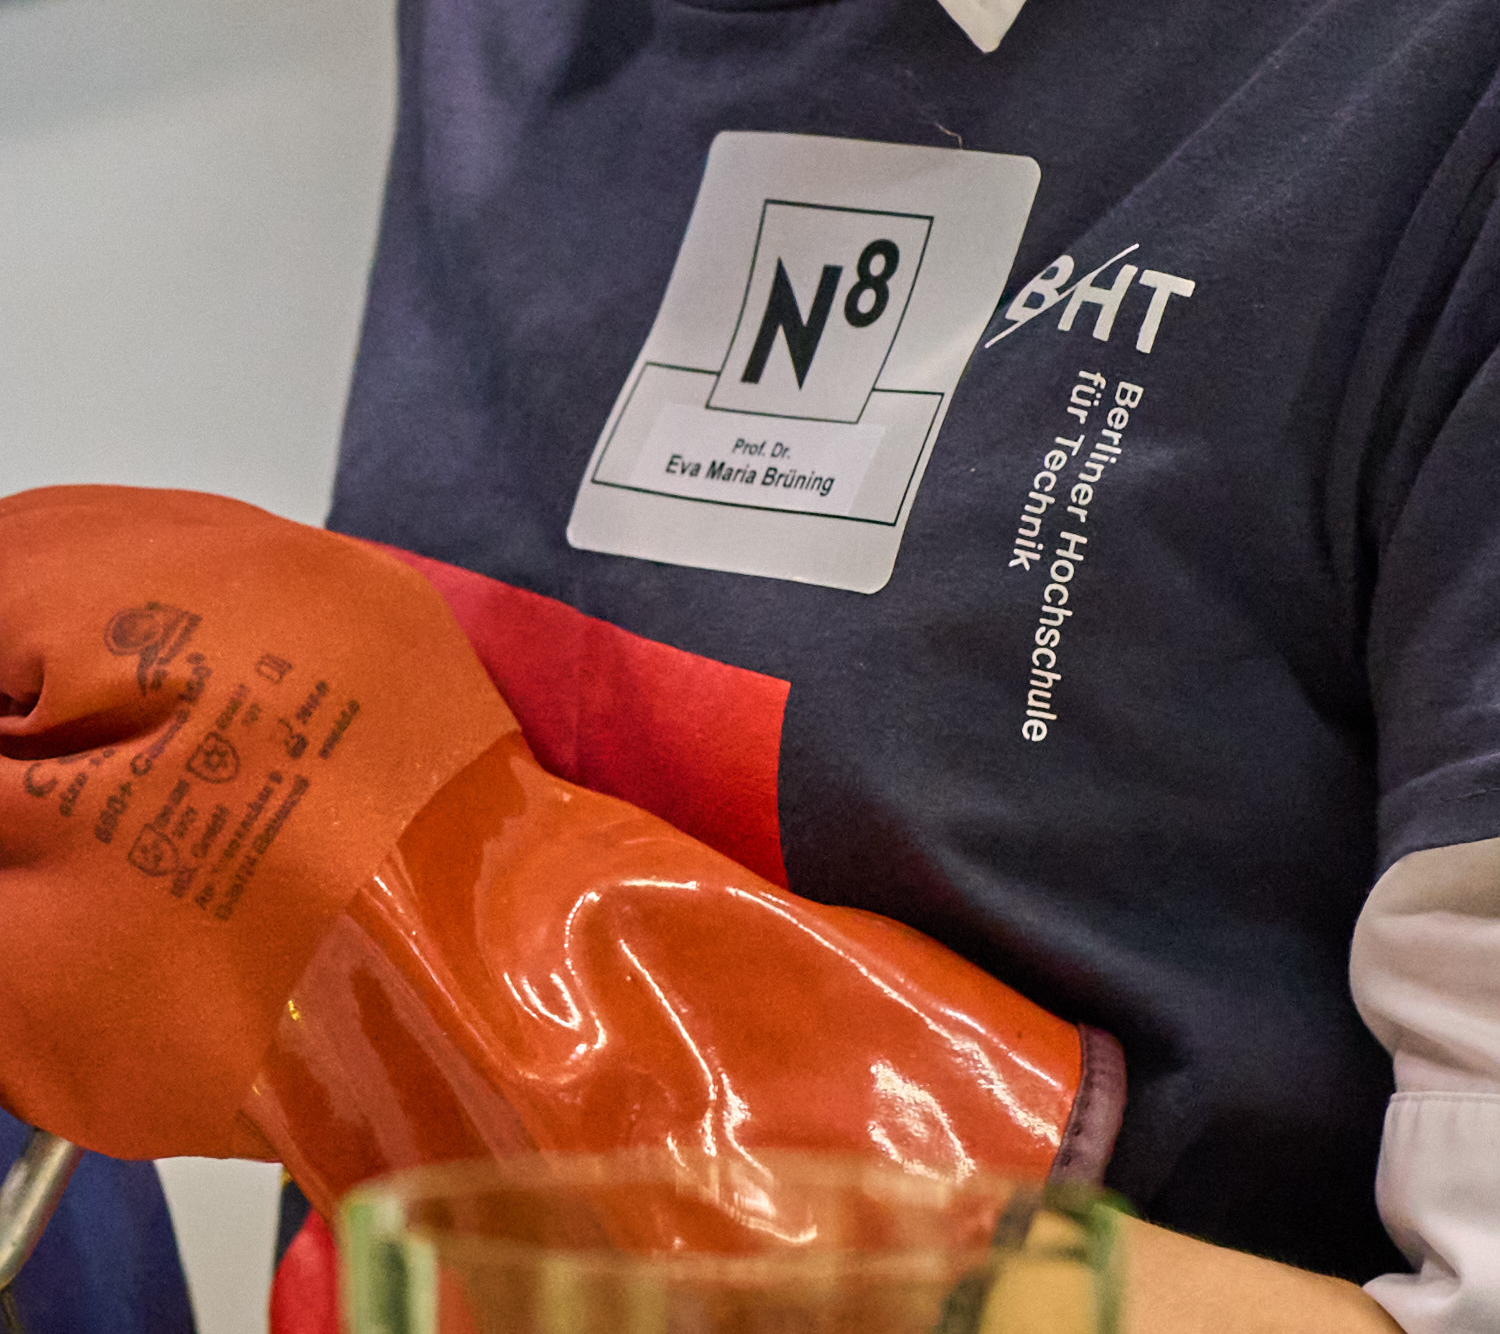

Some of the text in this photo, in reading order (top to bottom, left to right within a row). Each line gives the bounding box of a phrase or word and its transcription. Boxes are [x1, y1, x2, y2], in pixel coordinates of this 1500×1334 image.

[985, 244, 1196, 354] BHT
[665, 454, 835, 497] Eva Maria Brüning
[732, 437, 791, 459] Prof. Dr.
[1008, 370, 1106, 571] für Technik
[1021, 380, 1145, 742] Berliner Hochschule
